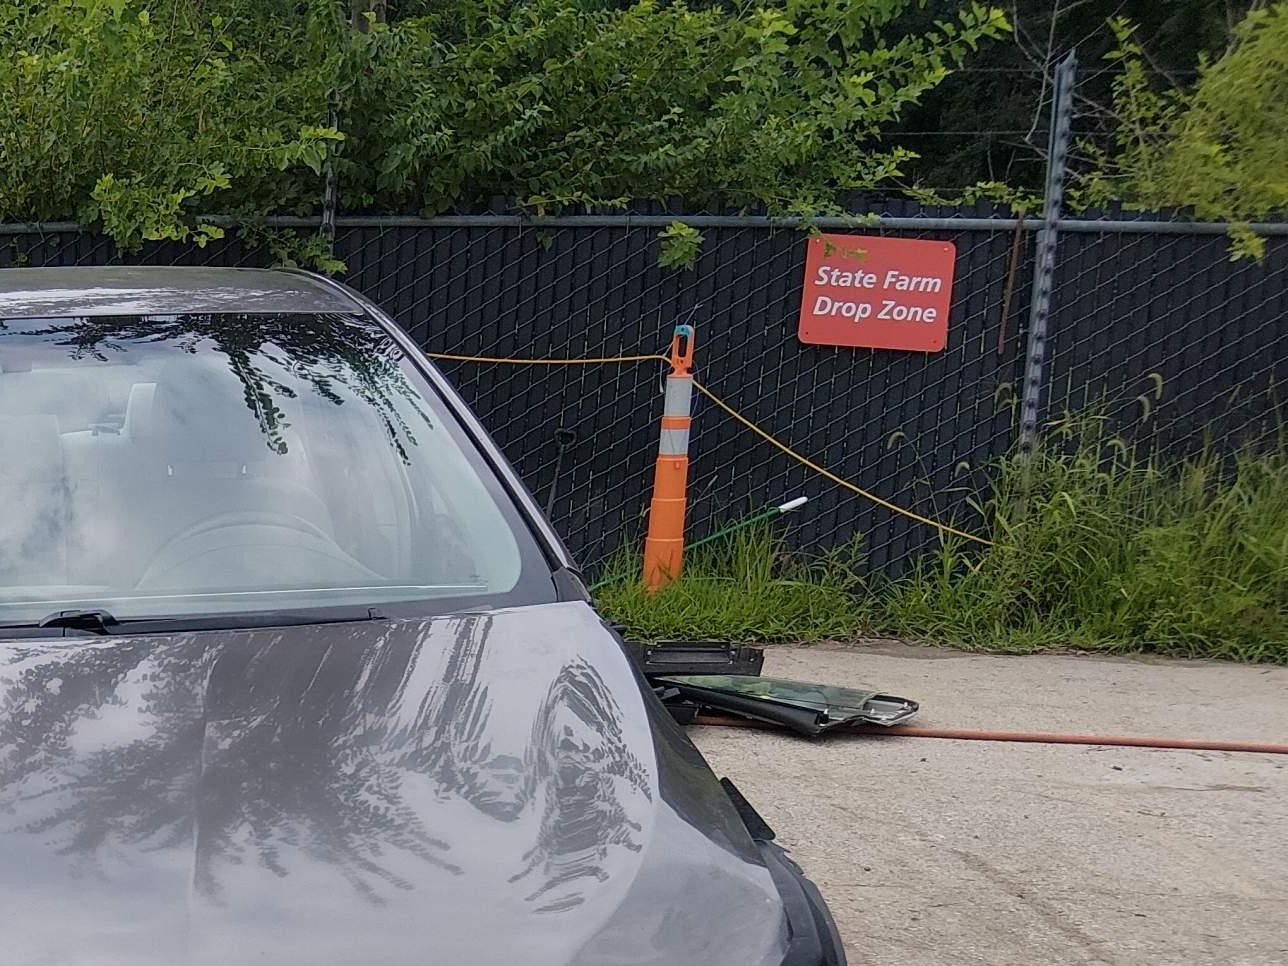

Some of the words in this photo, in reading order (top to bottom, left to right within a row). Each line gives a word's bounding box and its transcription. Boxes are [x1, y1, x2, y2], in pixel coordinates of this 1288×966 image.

[814, 265, 878, 289] State
[882, 270, 942, 293] Farm
[813, 296, 872, 323] Drop
[877, 300, 937, 323] Zone
